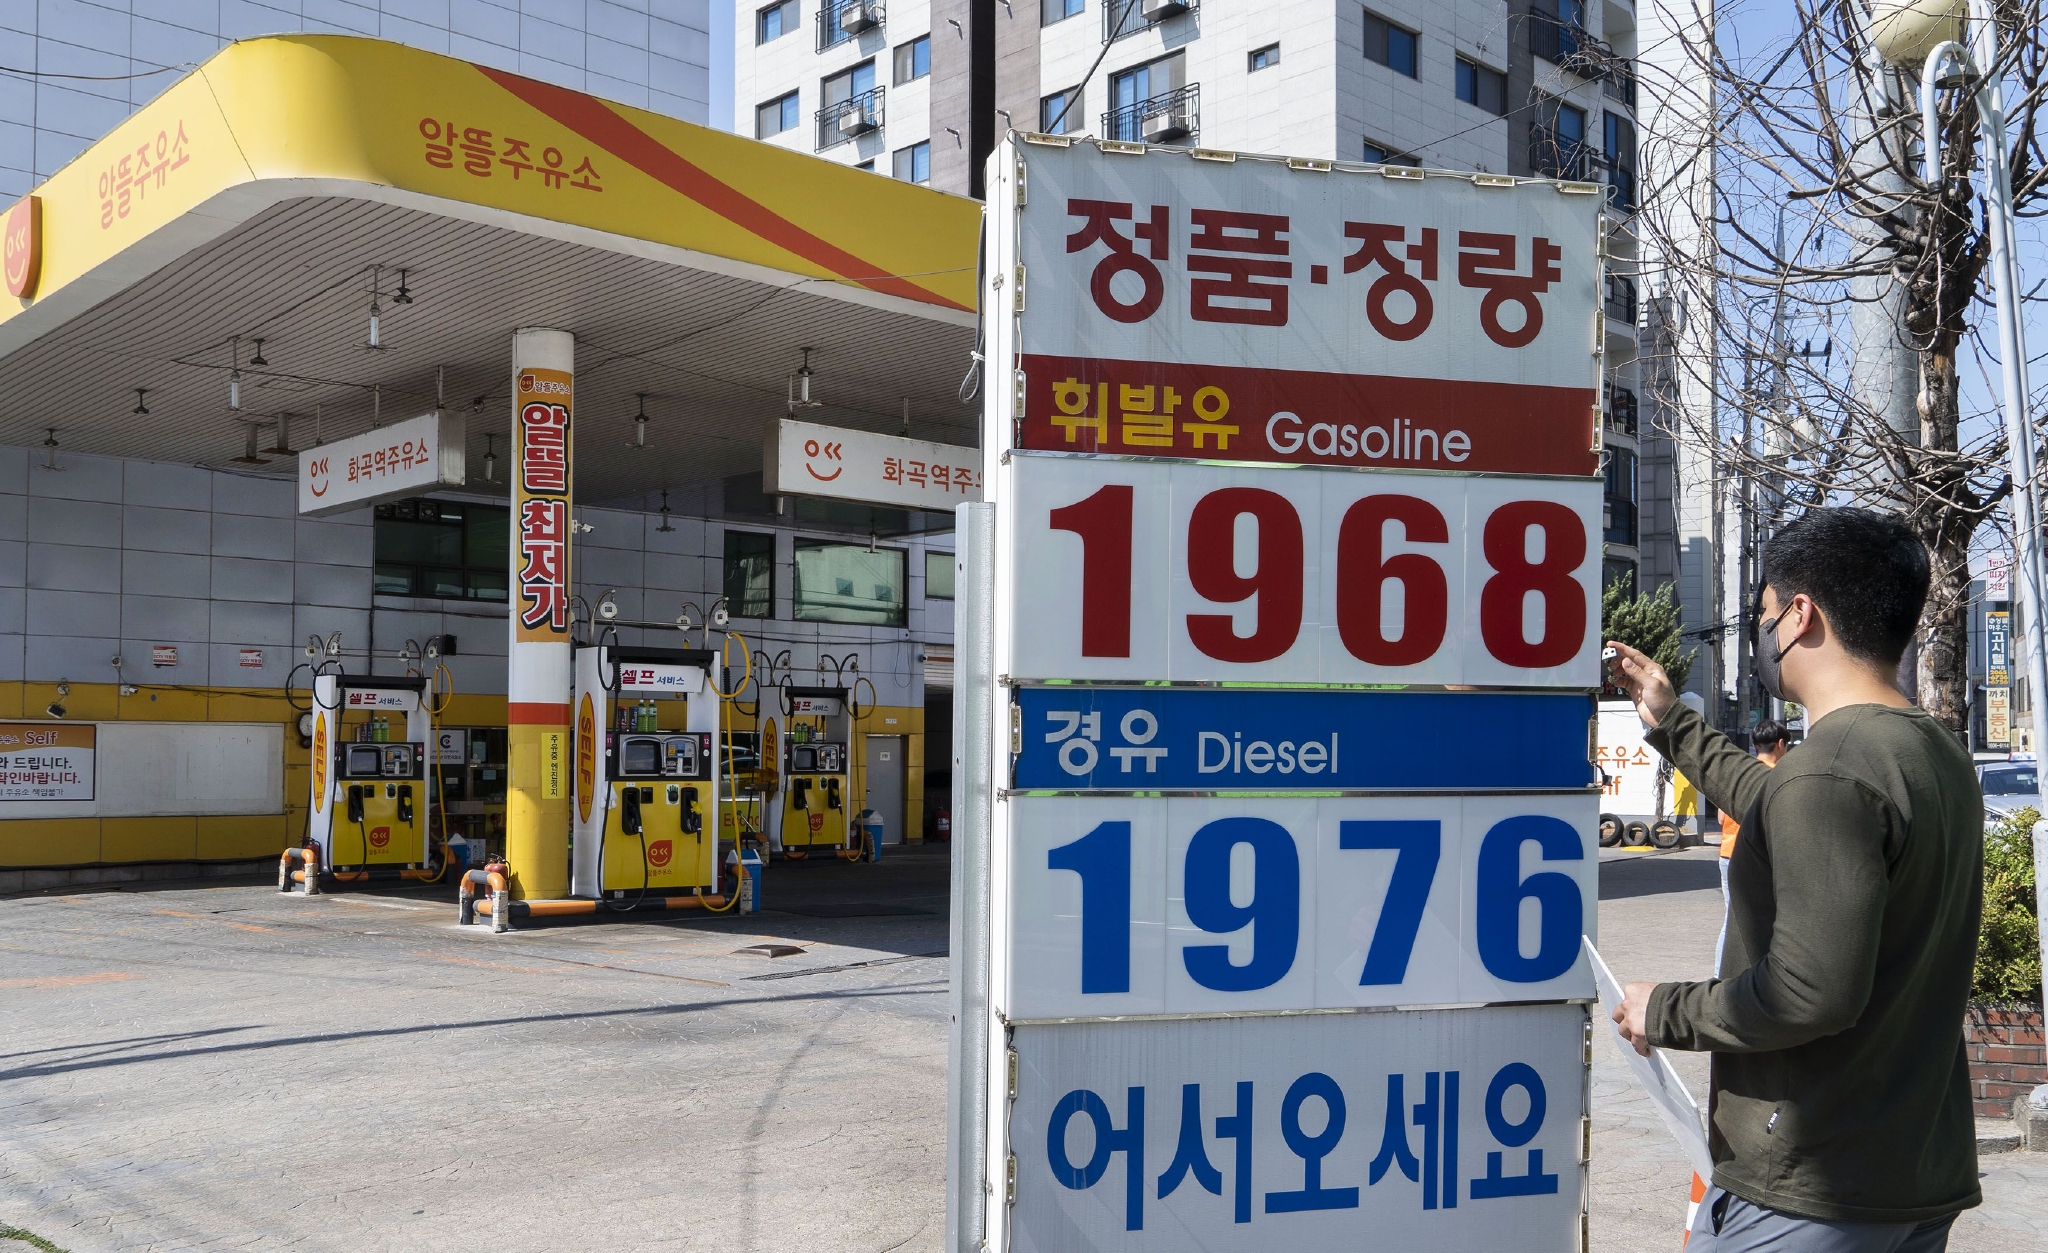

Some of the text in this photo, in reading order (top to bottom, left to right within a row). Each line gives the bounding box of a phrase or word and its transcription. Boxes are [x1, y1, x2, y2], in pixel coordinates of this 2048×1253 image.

[99, 119, 190, 230] 알뜰주유소
[418, 116, 603, 193] 알뜰주유소
[534, 381, 571, 394] 알뜰주유소
[1050, 377, 1472, 462] 휘발유 Gasoline
[348, 437, 429, 483] 화곡역주유소
[882, 457, 981, 494] 화곡역주
[520, 403, 568, 627] 알뜰 최저가
[1049, 484, 1587, 668] 1968
[349, 693, 402, 706] 셀프 서비스
[622, 669, 685, 686] 셀프 서비스
[1988, 689, 2008, 698] 까치
[811, 704, 829, 712] 서비스
[1989, 699, 2007, 740] 부동산
[13, 757, 72, 770] 드립니다.
[25, 731, 58, 745] Self
[316, 729, 325, 785] SELF
[581, 717, 591, 785] SELF
[1045, 709, 1338, 776] 경유 Diesel
[550, 734, 558, 797] 주유중 엔진정지
[6, 788, 29, 796] 주유소
[1047, 815, 1584, 994] 1976
[1046, 1062, 1559, 1231] 어서오세요
